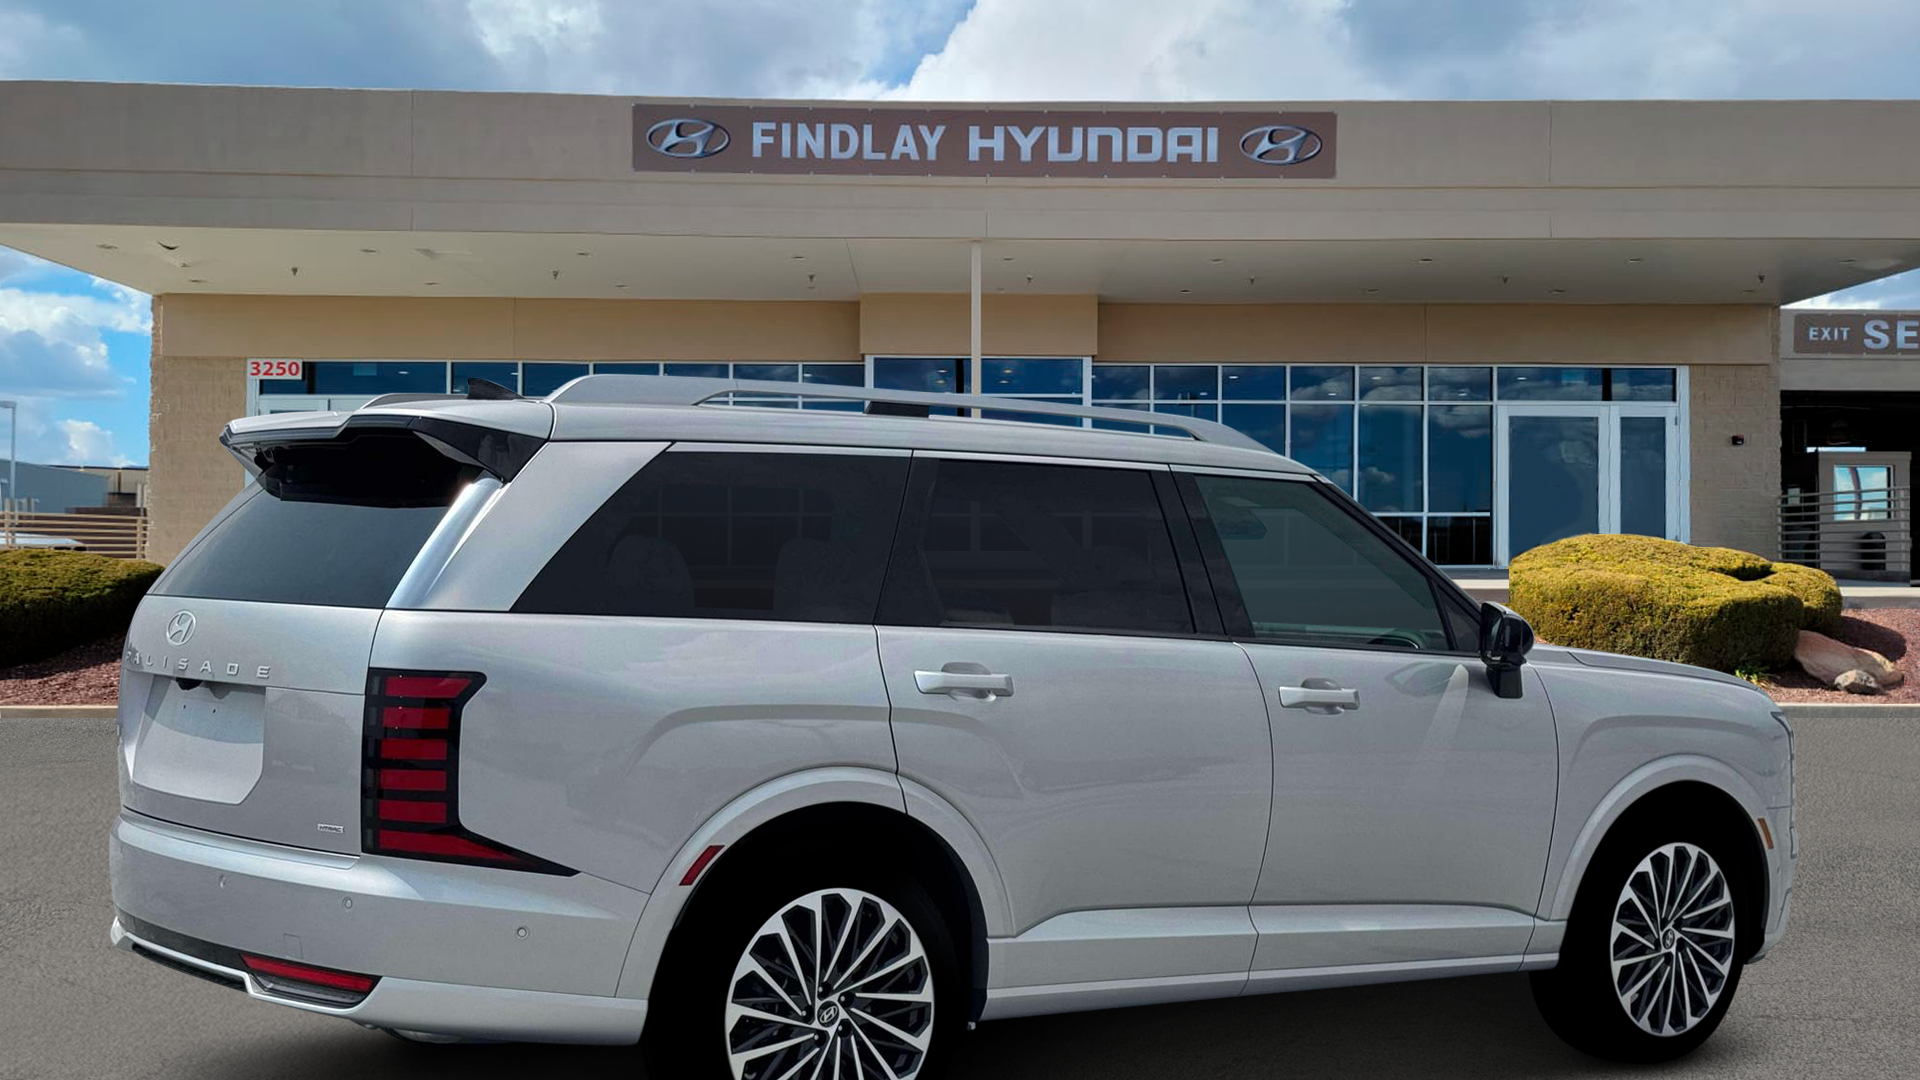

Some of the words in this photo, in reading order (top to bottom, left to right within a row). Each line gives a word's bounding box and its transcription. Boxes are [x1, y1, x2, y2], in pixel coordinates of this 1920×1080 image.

[752, 121, 946, 161] FINDLAY
[968, 125, 1219, 163] HYUNDAI
[1808, 327, 1850, 341] EXIT
[1863, 319, 1920, 350] SE
[249, 361, 300, 376] 3250
[126, 650, 271, 679] PALISADE
